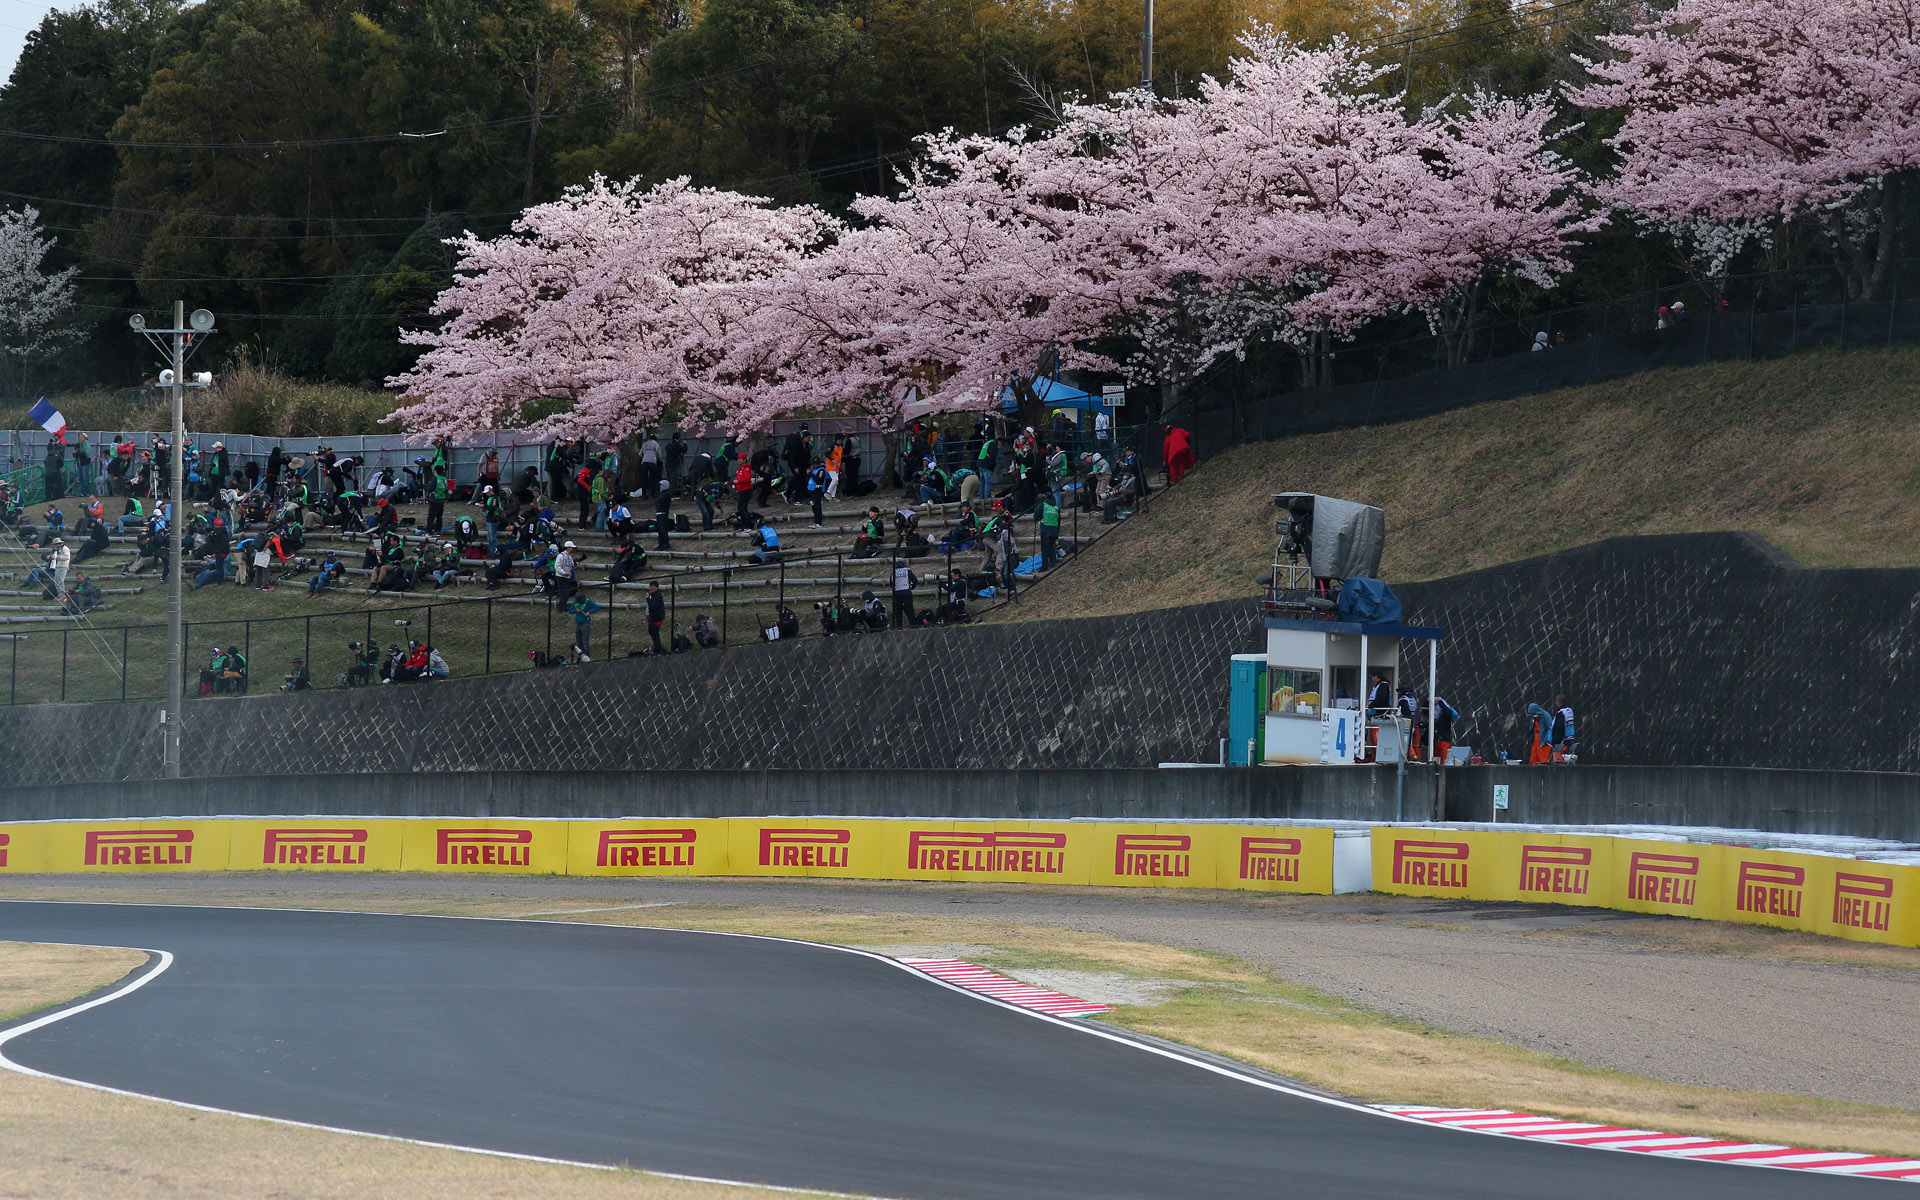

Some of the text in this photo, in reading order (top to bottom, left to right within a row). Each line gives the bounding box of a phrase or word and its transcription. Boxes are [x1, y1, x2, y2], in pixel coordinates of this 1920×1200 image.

[1336, 718, 1346, 757] 4
[85, 830, 193, 865] PIRELLI
[264, 829, 367, 864] PIRELLI
[437, 829, 532, 865] PIRELLI
[597, 829, 696, 866] PIRELLI
[760, 829, 850, 867] PIRELLI
[1116, 835, 1191, 876] PIRELLI
[1240, 837, 1301, 881] PIRELLI
[1393, 840, 1469, 887] PIRELLI
[1520, 846, 1591, 893] PIRELLI
[1629, 852, 1699, 904] PIRELLI
[1738, 862, 1805, 917] PIRELLI
[1834, 872, 1893, 930] PIRELLI
